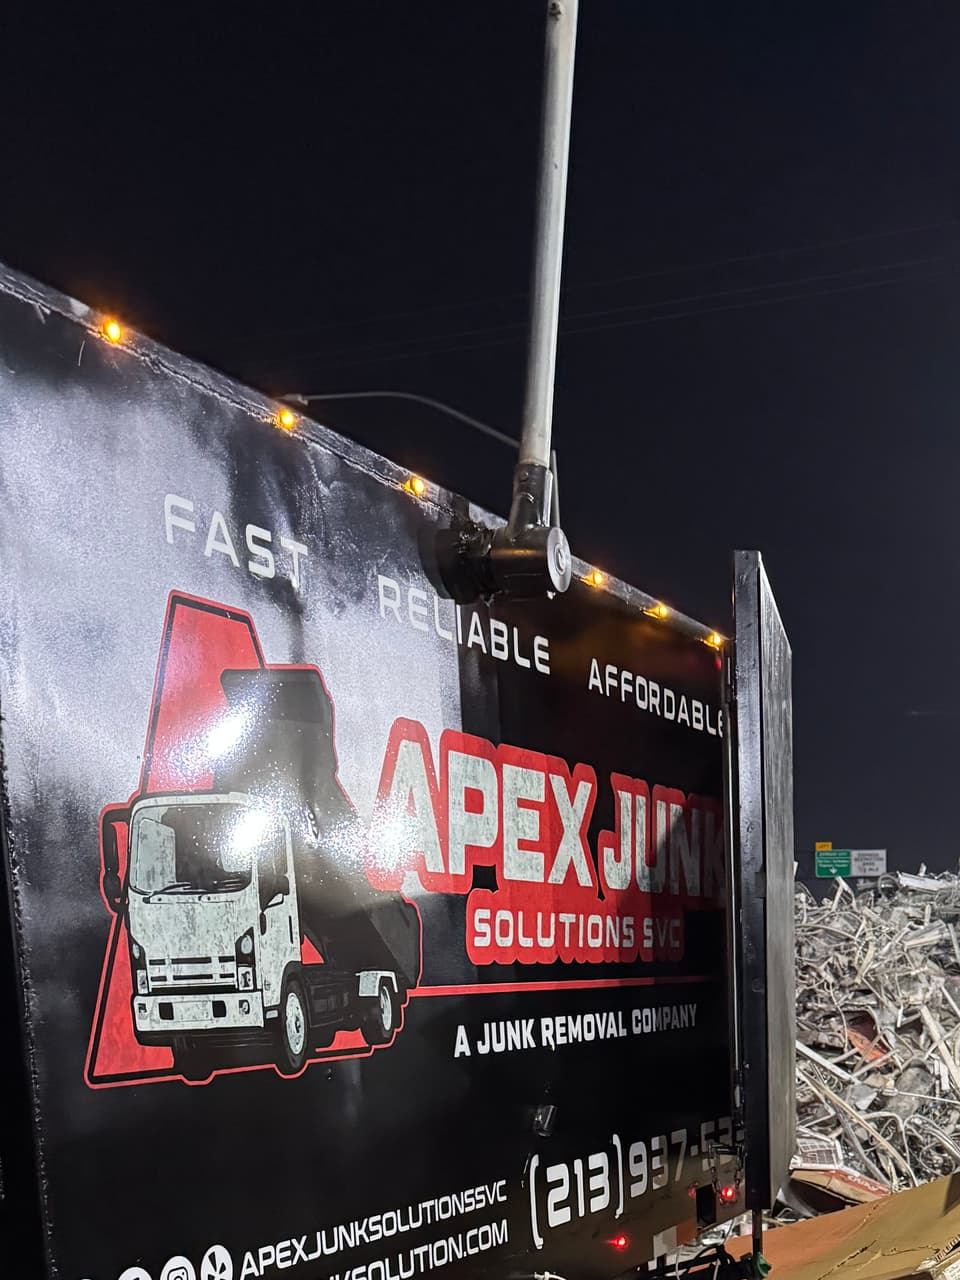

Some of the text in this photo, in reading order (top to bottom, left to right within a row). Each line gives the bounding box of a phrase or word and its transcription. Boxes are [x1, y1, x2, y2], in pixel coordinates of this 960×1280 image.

[163, 494, 308, 593] FAST
[378, 575, 550, 676] RELIABLE
[370, 738, 594, 889] APEX
[474, 909, 681, 950] SOLUTIONS SVC
[454, 1003, 697, 1058] A JUNK REMOVAL COMPANY
